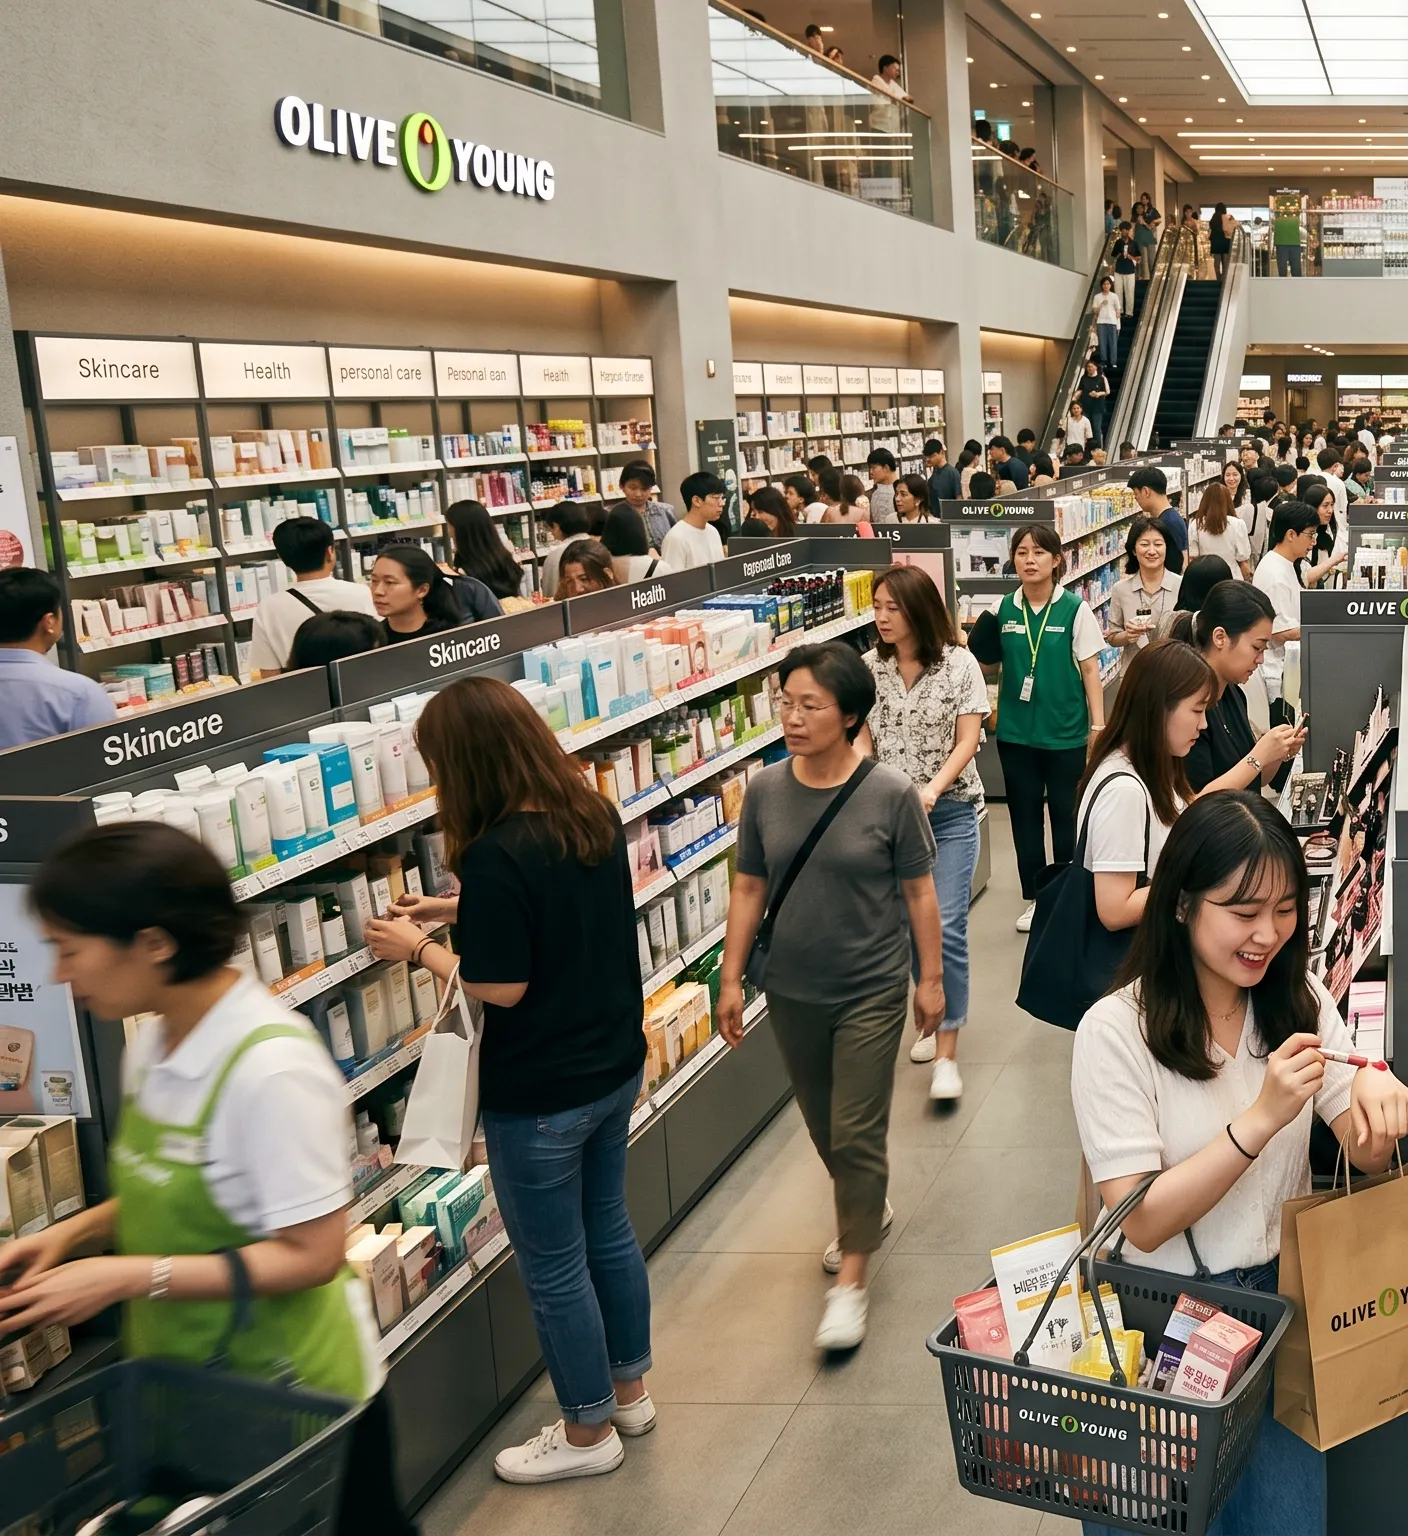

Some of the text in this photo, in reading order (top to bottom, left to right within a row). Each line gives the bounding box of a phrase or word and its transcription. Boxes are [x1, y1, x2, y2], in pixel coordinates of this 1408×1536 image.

[274, 95, 556, 202] OLIVE YOUNG
[78, 358, 160, 379] Skincare
[243, 361, 292, 380] Health
[340, 364, 422, 383] personal care
[447, 366, 487, 381] Personal
[961, 505, 1035, 515] OLIVE YOUNG
[630, 584, 667, 610] Health
[1346, 601, 1397, 616] OLIVE
[428, 630, 502, 669] Skincare
[102, 712, 225, 767] Skincare
[1330, 1299, 1377, 1332] OLIVE
[1018, 1408, 1128, 1441] OLIVE YOUNG
